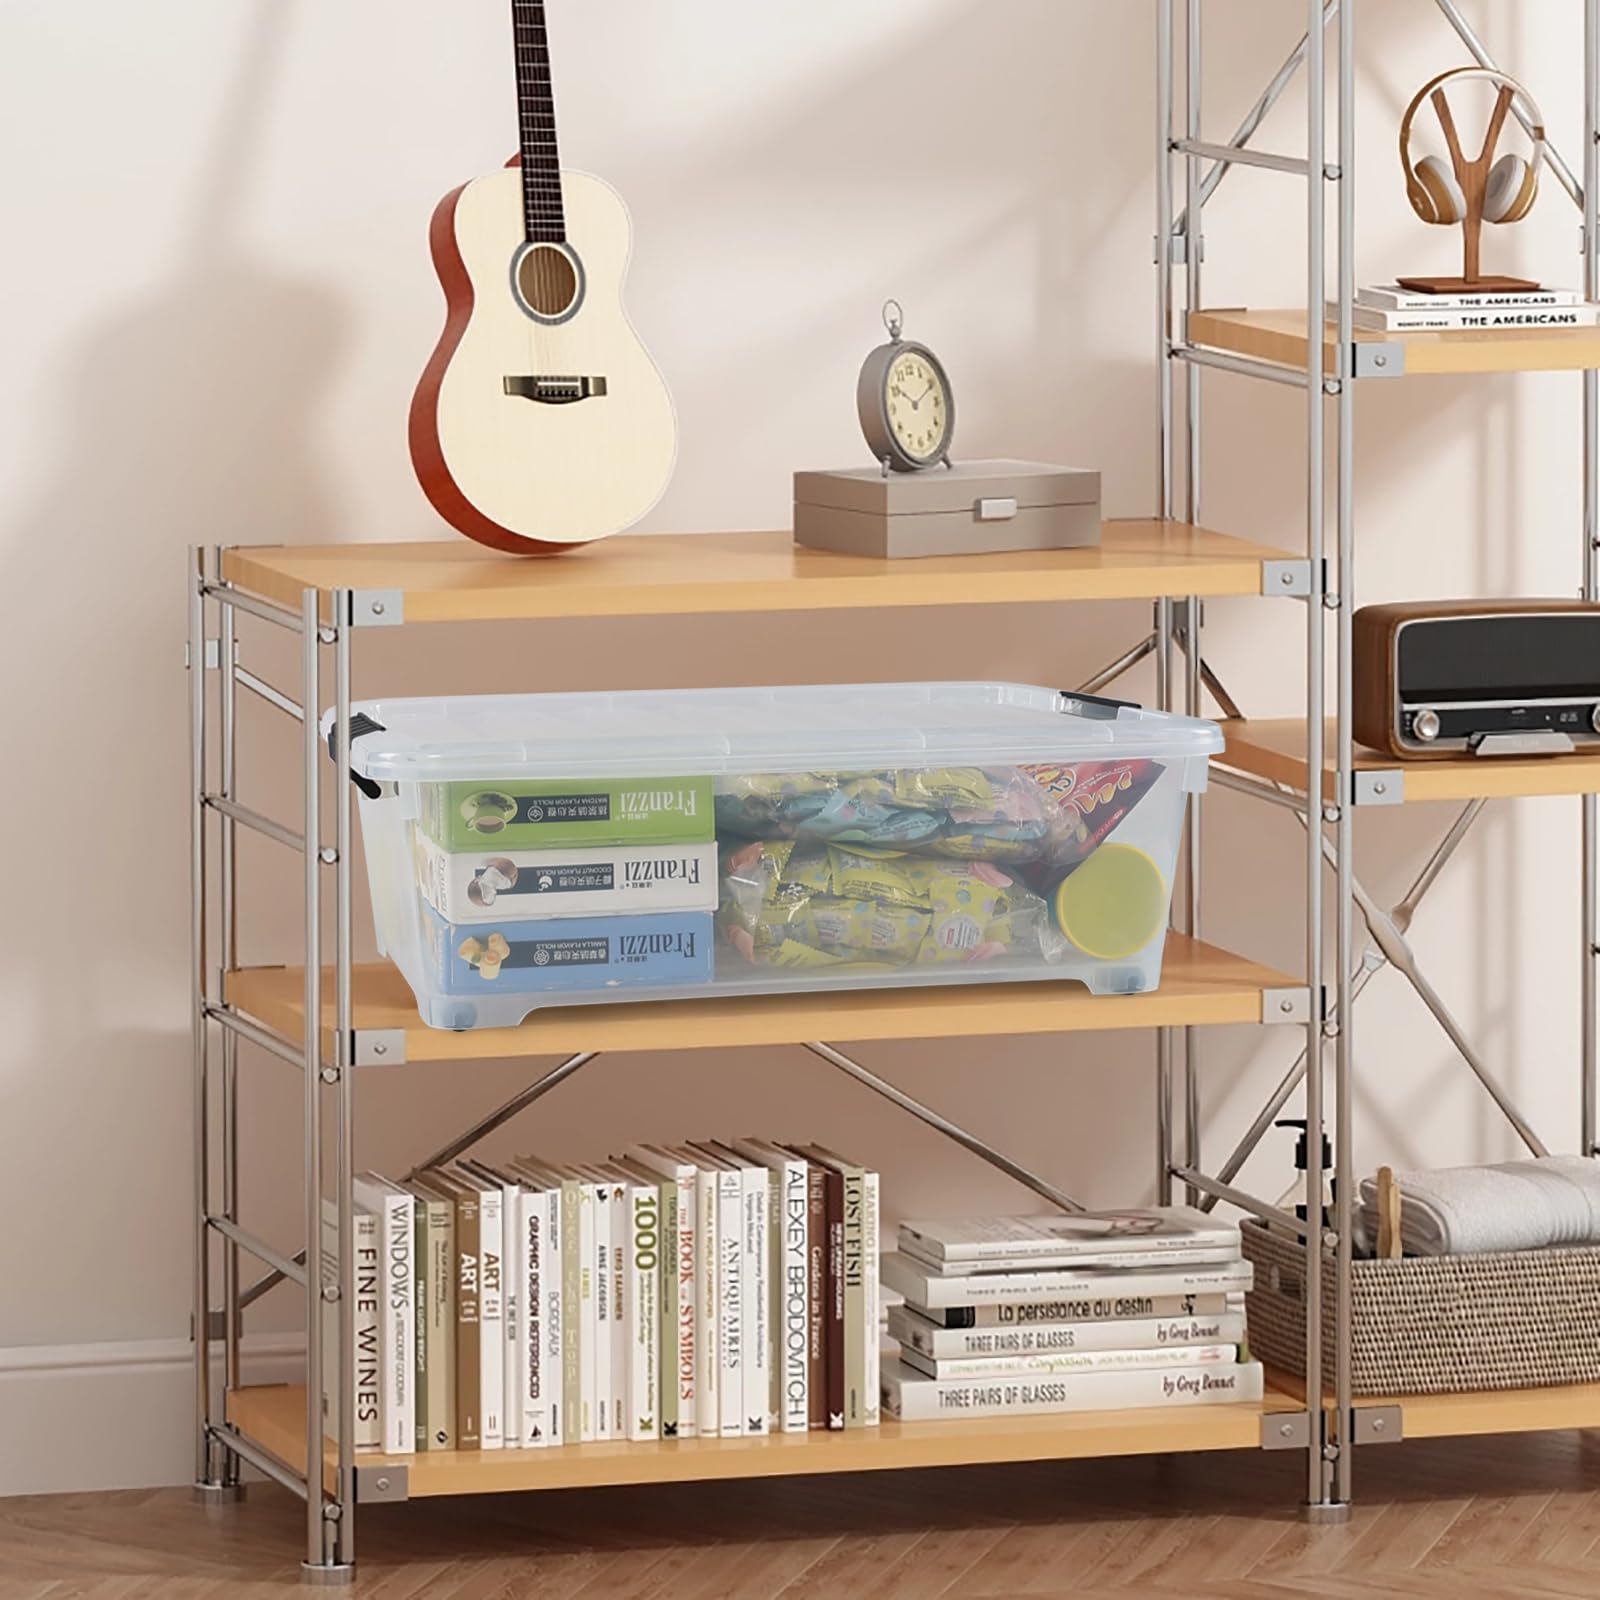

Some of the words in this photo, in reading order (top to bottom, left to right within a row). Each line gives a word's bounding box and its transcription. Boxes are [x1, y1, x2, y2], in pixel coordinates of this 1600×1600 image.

[1461, 317, 1487, 325] THE
[1493, 315, 1577, 324] AMERICANS
[1486, 297, 1556, 305] AMERICANS
[621, 790, 696, 816] Franzzi
[625, 859, 699, 884] Franzzi
[620, 932, 696, 961] Franzzi
[787, 1170, 805, 1257] ALEXEY
[846, 1176, 861, 1232] LOST
[866, 1186, 876, 1248] MAKING
[390, 1204, 409, 1310] WINDOWS
[529, 1216, 540, 1270] GRAPHIC
[598, 1245, 607, 1270] ARNE
[635, 1196, 656, 1270] 1000
[680, 1231, 693, 1284] BOOK
[358, 1248, 376, 1313] FINE
[460, 1254, 476, 1294] ART
[484, 1253, 499, 1292] ART
[811, 1246, 821, 1299] Gardens
[846, 1238, 861, 1287] FISH
[866, 1252, 876, 1267] IT
[529, 1272, 540, 1317] DESIGN
[598, 1272, 607, 1321] JACOBSEN
[615, 1274, 623, 1321] SAARINEN
[723, 1238, 739, 1368] ANTIQUAIRES
[811, 1301, 820, 1313] in
[998, 1304, 1013, 1320] La
[1017, 1298, 1091, 1325] persistance
[1094, 1302, 1110, 1316] du
[1115, 1297, 1152, 1315] destin
[548, 1292, 560, 1358] BORDEAUX
[787, 1266, 805, 1415] BRODOVITCH
[812, 1316, 821, 1360] France
[965, 1336, 992, 1352] THREE
[995, 1334, 1020, 1351] PAIRS
[1022, 1333, 1033, 1348] OF
[1037, 1331, 1075, 1347] GLASSES
[1156, 1324, 1167, 1342] by
[1168, 1324, 1189, 1341] Greg
[1191, 1322, 1220, 1338] Bennet
[358, 1326, 377, 1422] WINES
[529, 1320, 540, 1399] REFERENCED
[680, 1305, 694, 1400] SYMBOLS
[938, 1390, 970, 1408] THREE
[972, 1388, 1002, 1407] PAIRS
[1005, 1387, 1018, 1404] OF
[1022, 1383, 1066, 1402] GLASSES
[1163, 1376, 1174, 1396] by
[1176, 1375, 1201, 1394] Greg
[1202, 1374, 1235, 1390] Bennet
